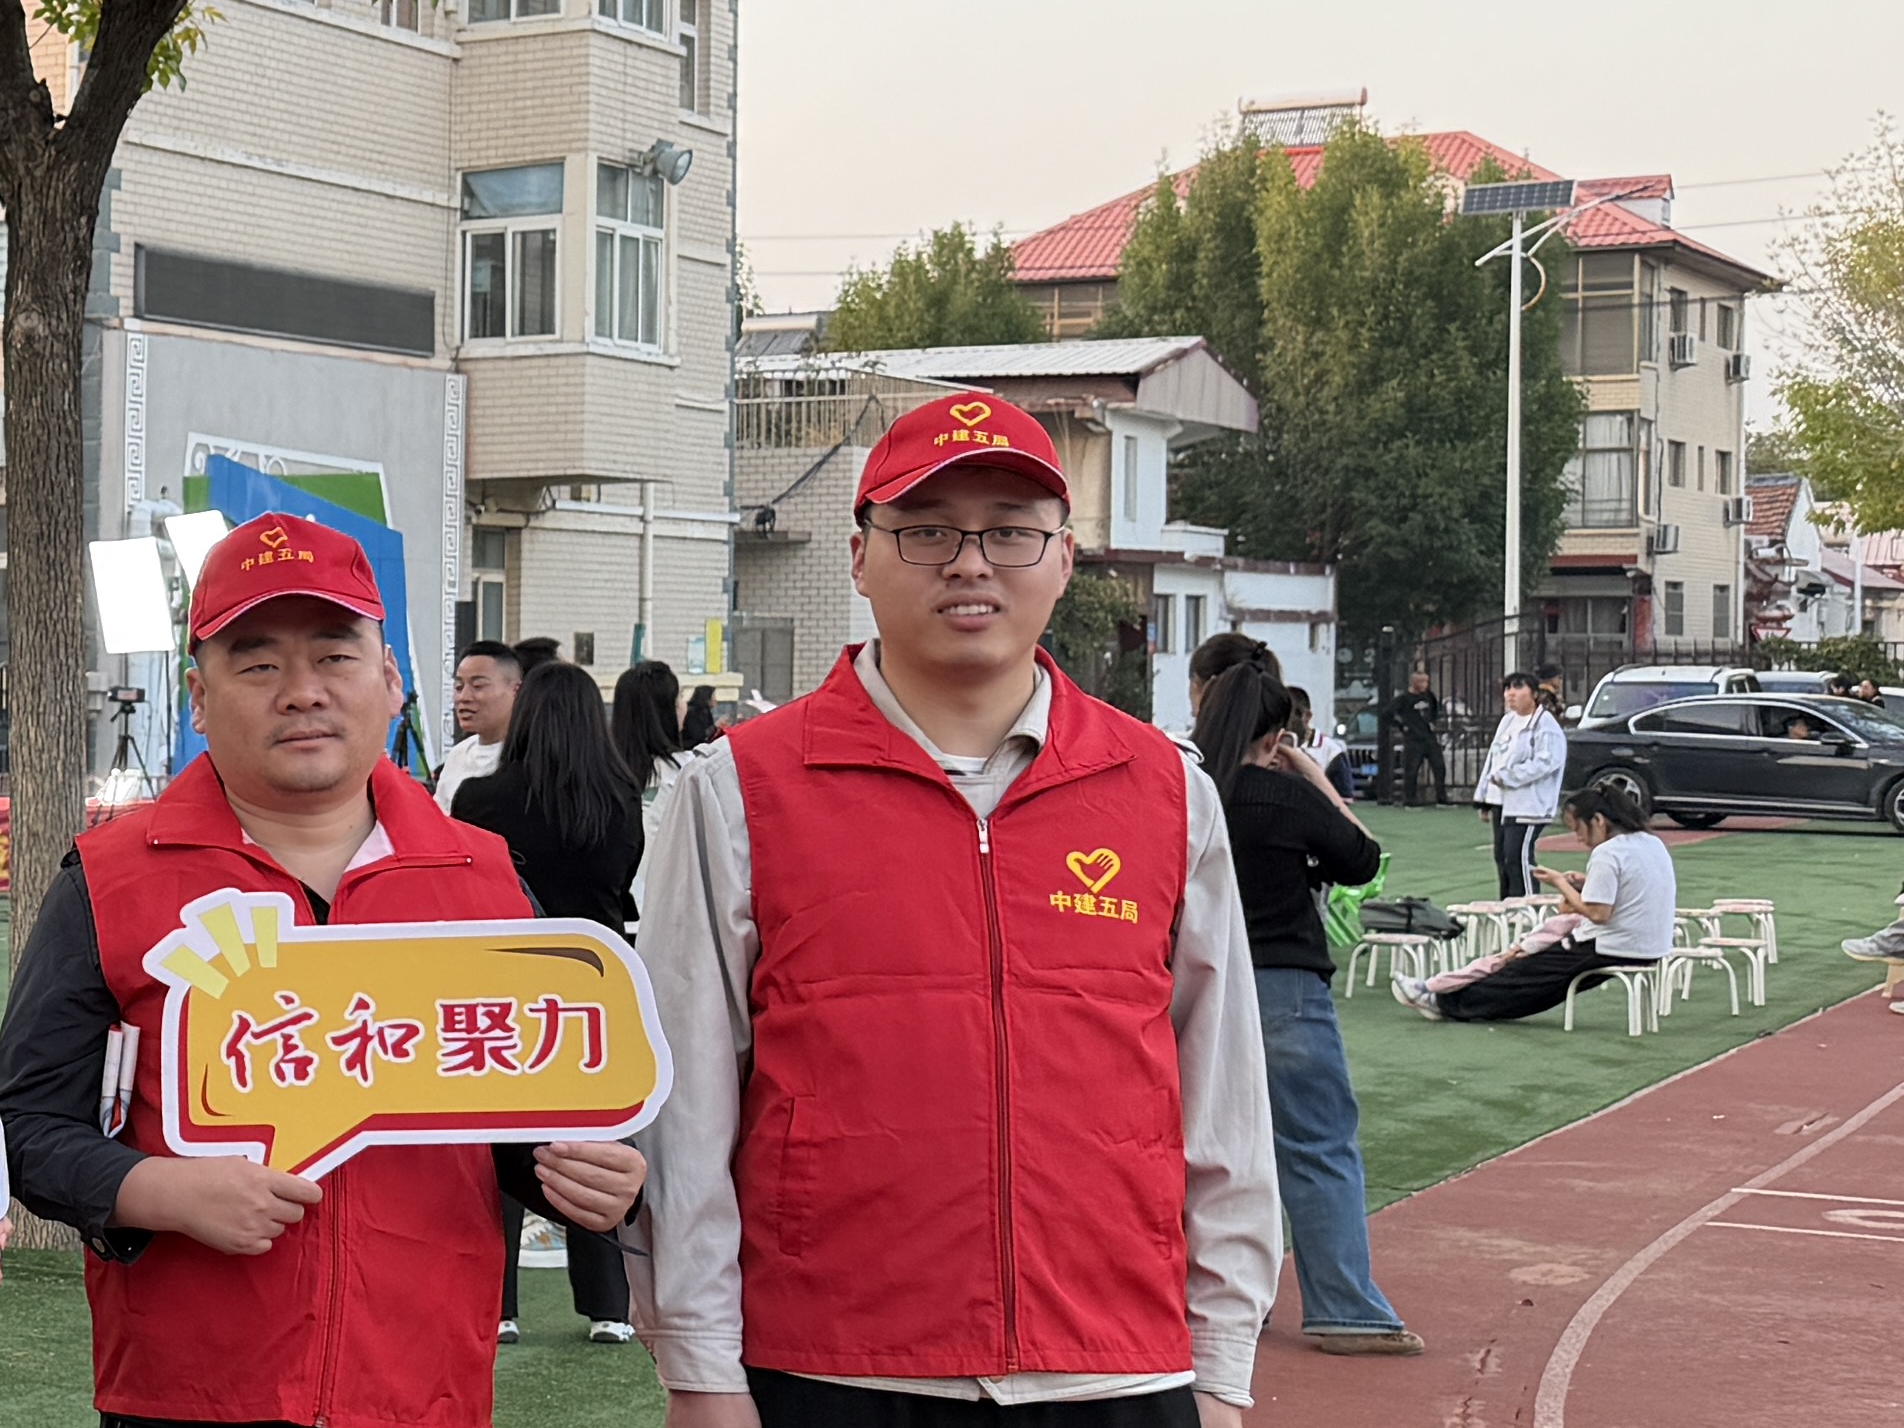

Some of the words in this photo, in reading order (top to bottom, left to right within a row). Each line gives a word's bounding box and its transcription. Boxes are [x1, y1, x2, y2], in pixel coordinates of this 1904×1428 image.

[933, 429, 1010, 448] 中建五局
[240, 548, 315, 571] 中建五局
[1049, 890, 1138, 924] 中建五局
[221, 990, 607, 1094] 信和聚力
